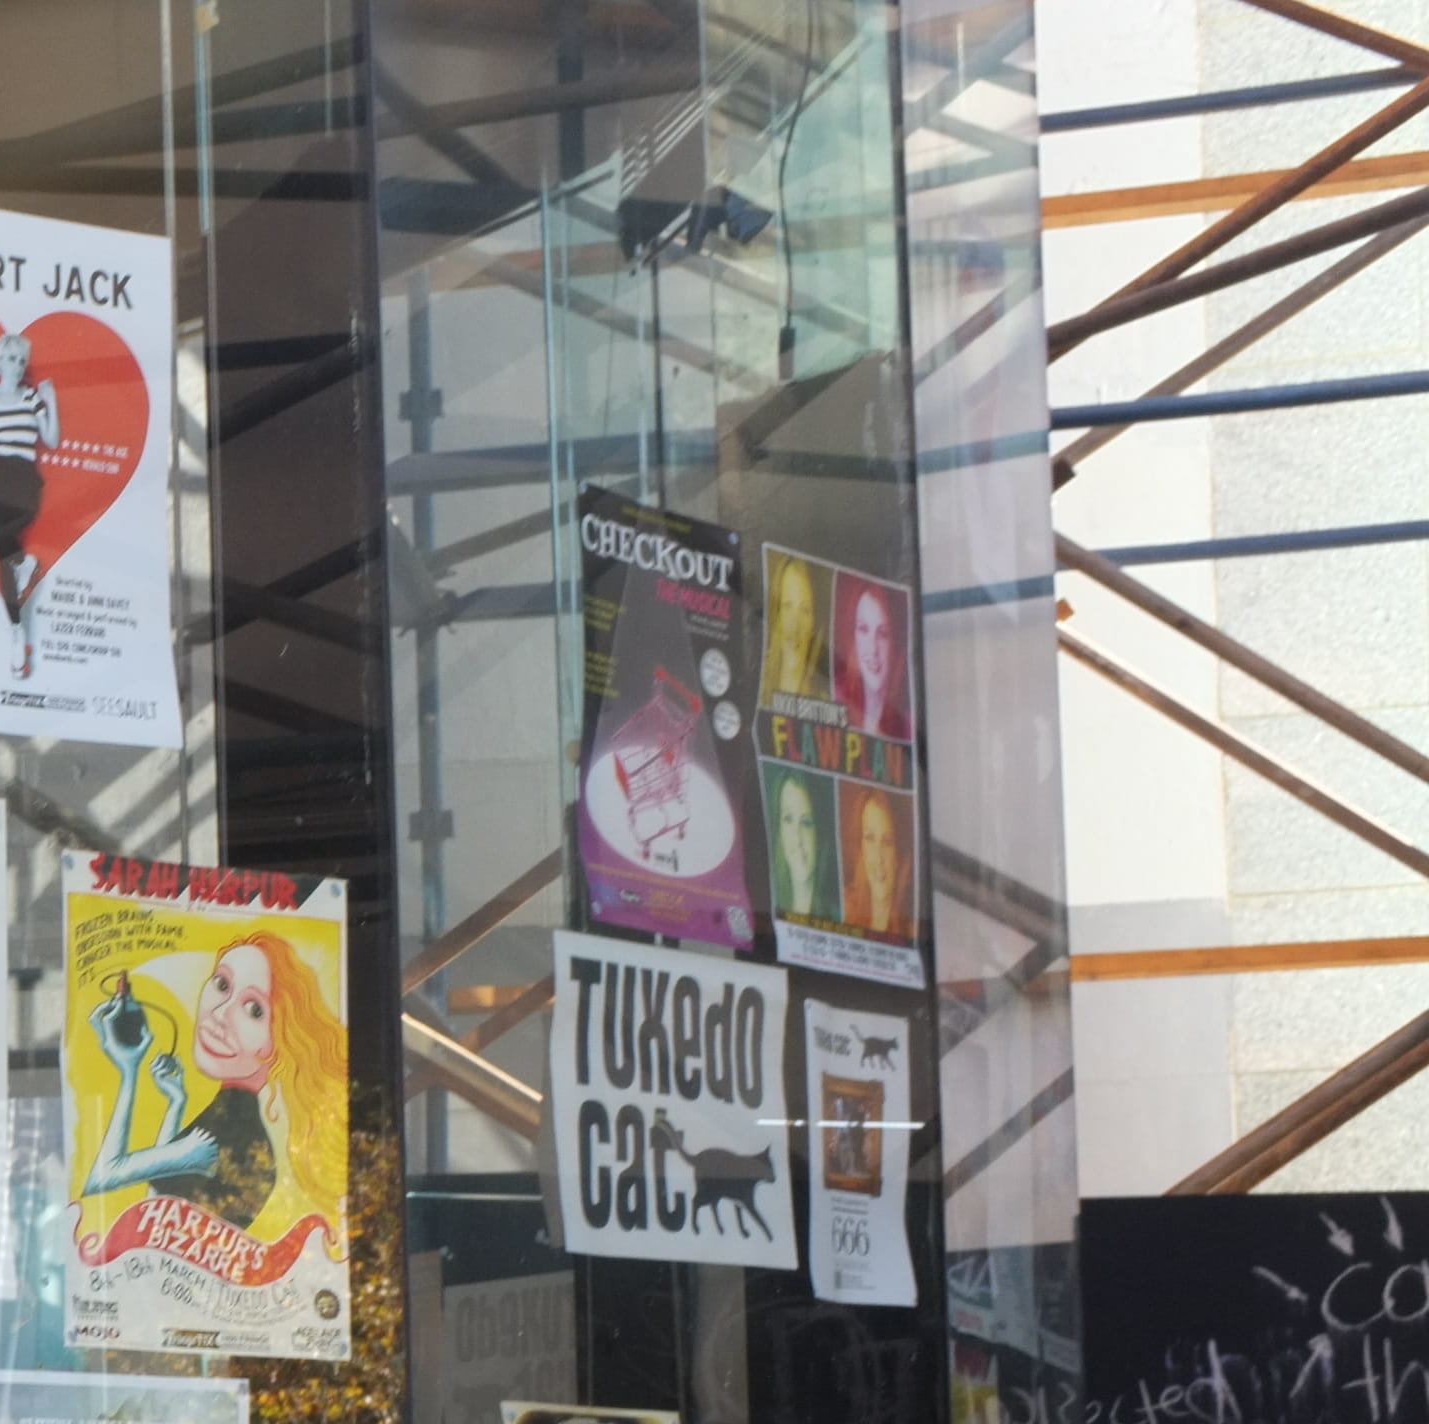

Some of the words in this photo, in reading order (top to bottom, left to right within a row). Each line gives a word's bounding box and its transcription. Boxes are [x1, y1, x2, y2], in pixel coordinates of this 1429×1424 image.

[43, 264, 133, 311] JACK
[581, 512, 733, 592] CHECKOUT
[773, 715, 842, 768] FLAW
[831, 1216, 870, 1257] 666
